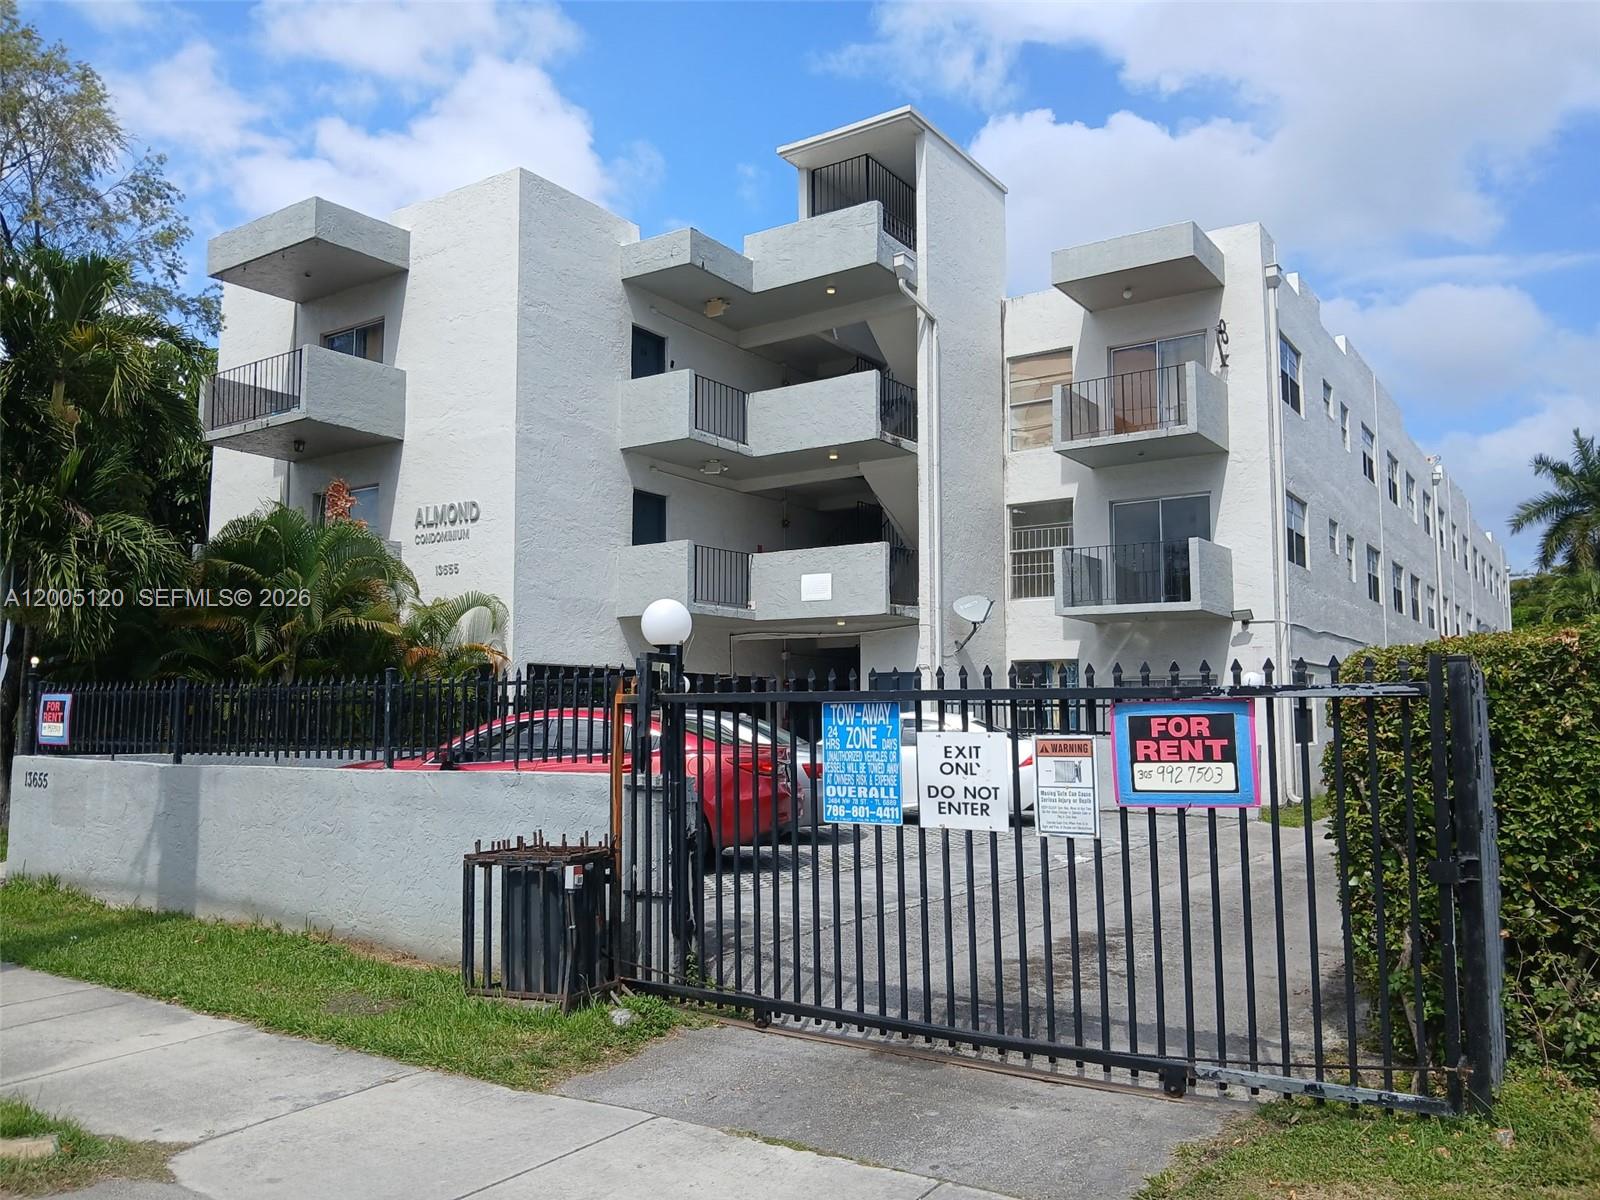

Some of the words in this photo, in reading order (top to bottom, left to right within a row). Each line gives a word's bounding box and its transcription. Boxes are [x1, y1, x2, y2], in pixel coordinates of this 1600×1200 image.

[414, 501, 480, 529] ALMOND
[414, 528, 470, 545] CONDOMINIUM
[46, 701, 60, 711] FOR
[43, 712, 63, 722] RENT
[830, 703, 891, 725] TOW-AWAY
[827, 726, 838, 737] 24
[887, 726, 893, 737] 7
[1150, 716, 1211, 738] FOR
[825, 739, 840, 750] HRS
[845, 727, 877, 749] ZONE
[881, 739, 898, 750] DAYS
[944, 746, 981, 759] EXIT
[1051, 743, 1088, 753] WARNING
[1136, 739, 1228, 761] RENT
[826, 751, 863, 762] UNAUTHORIZED
[864, 751, 887, 762] VEHICLES
[889, 751, 897, 762] OR
[847, 763, 858, 773] WILL
[859, 763, 866, 773] BE
[867, 763, 885, 774] TOWED
[1137, 769, 1153, 780] 305
[1156, 765, 1183, 784] 992
[1187, 766, 1223, 784] 7503
[24, 771, 49, 789] 13655
[826, 774, 833, 784] AT
[834, 774, 854, 785] OWNERS
[856, 774, 867, 785] RISK
[875, 774, 897, 786] EXPENSE
[826, 786, 898, 799] OVERALL
[927, 785, 955, 798] DO
[964, 786, 999, 800] NOT
[826, 804, 899, 819] 786-801-4411
[938, 802, 990, 816] ENTER
